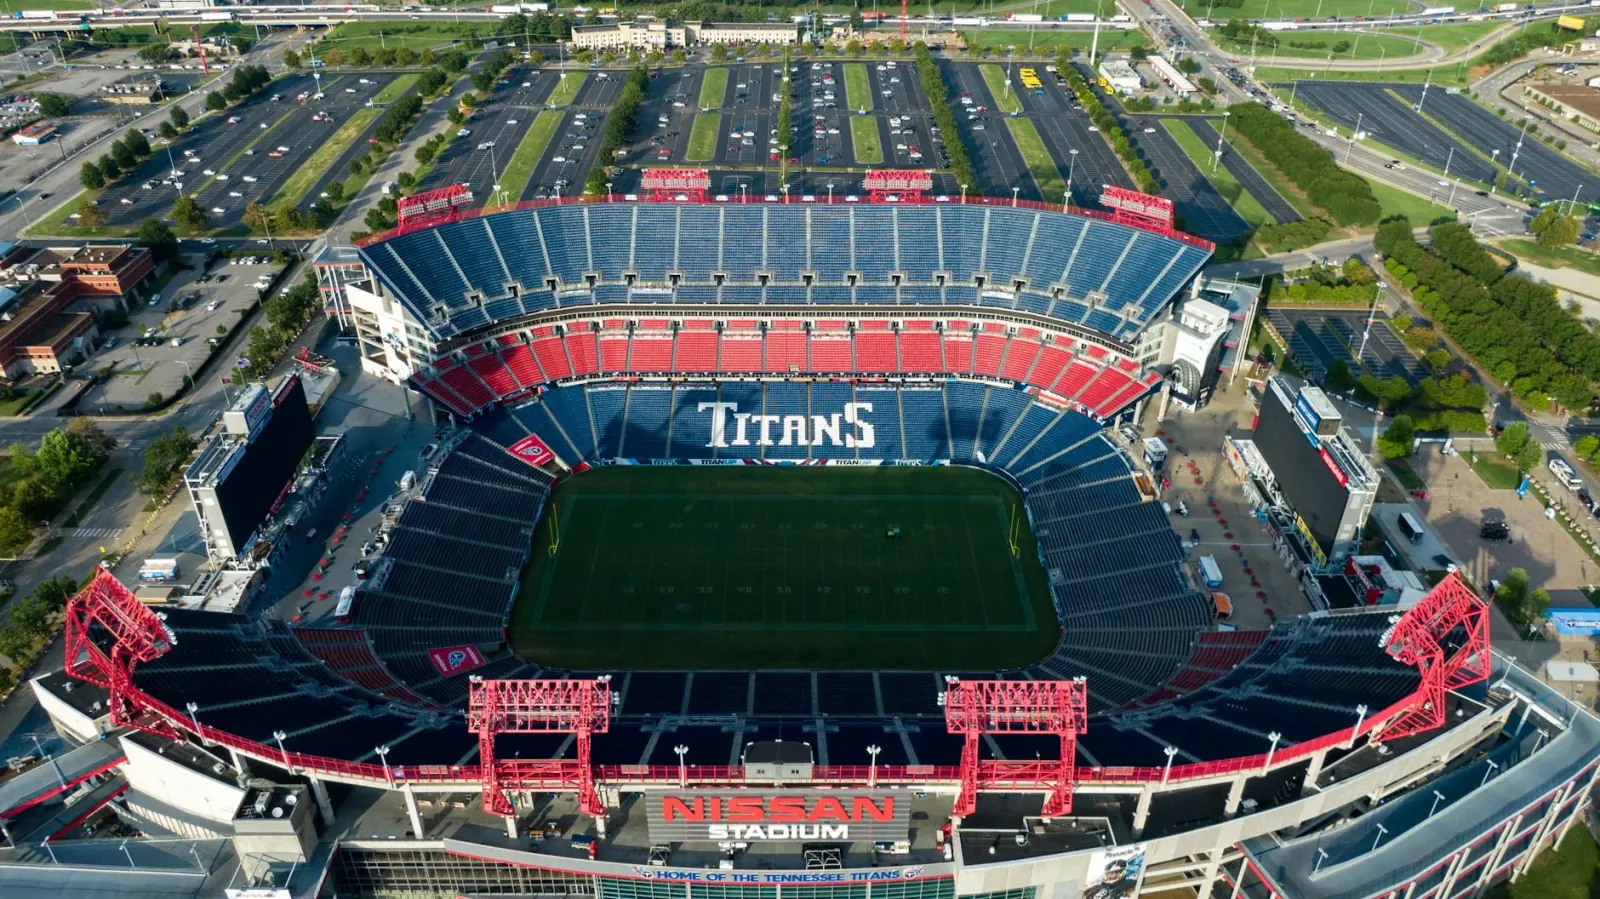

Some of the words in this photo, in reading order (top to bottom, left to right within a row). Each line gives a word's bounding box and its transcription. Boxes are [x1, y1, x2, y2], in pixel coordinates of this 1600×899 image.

[698, 402, 875, 448] TITANS
[662, 796, 895, 822] NISSAN
[708, 824, 849, 840] STADIUM
[657, 871, 701, 881] HOME
[706, 873, 726, 882] OF
[732, 873, 759, 882] THE
[764, 873, 845, 883] TENNESSEE
[850, 871, 900, 881] TITANS
